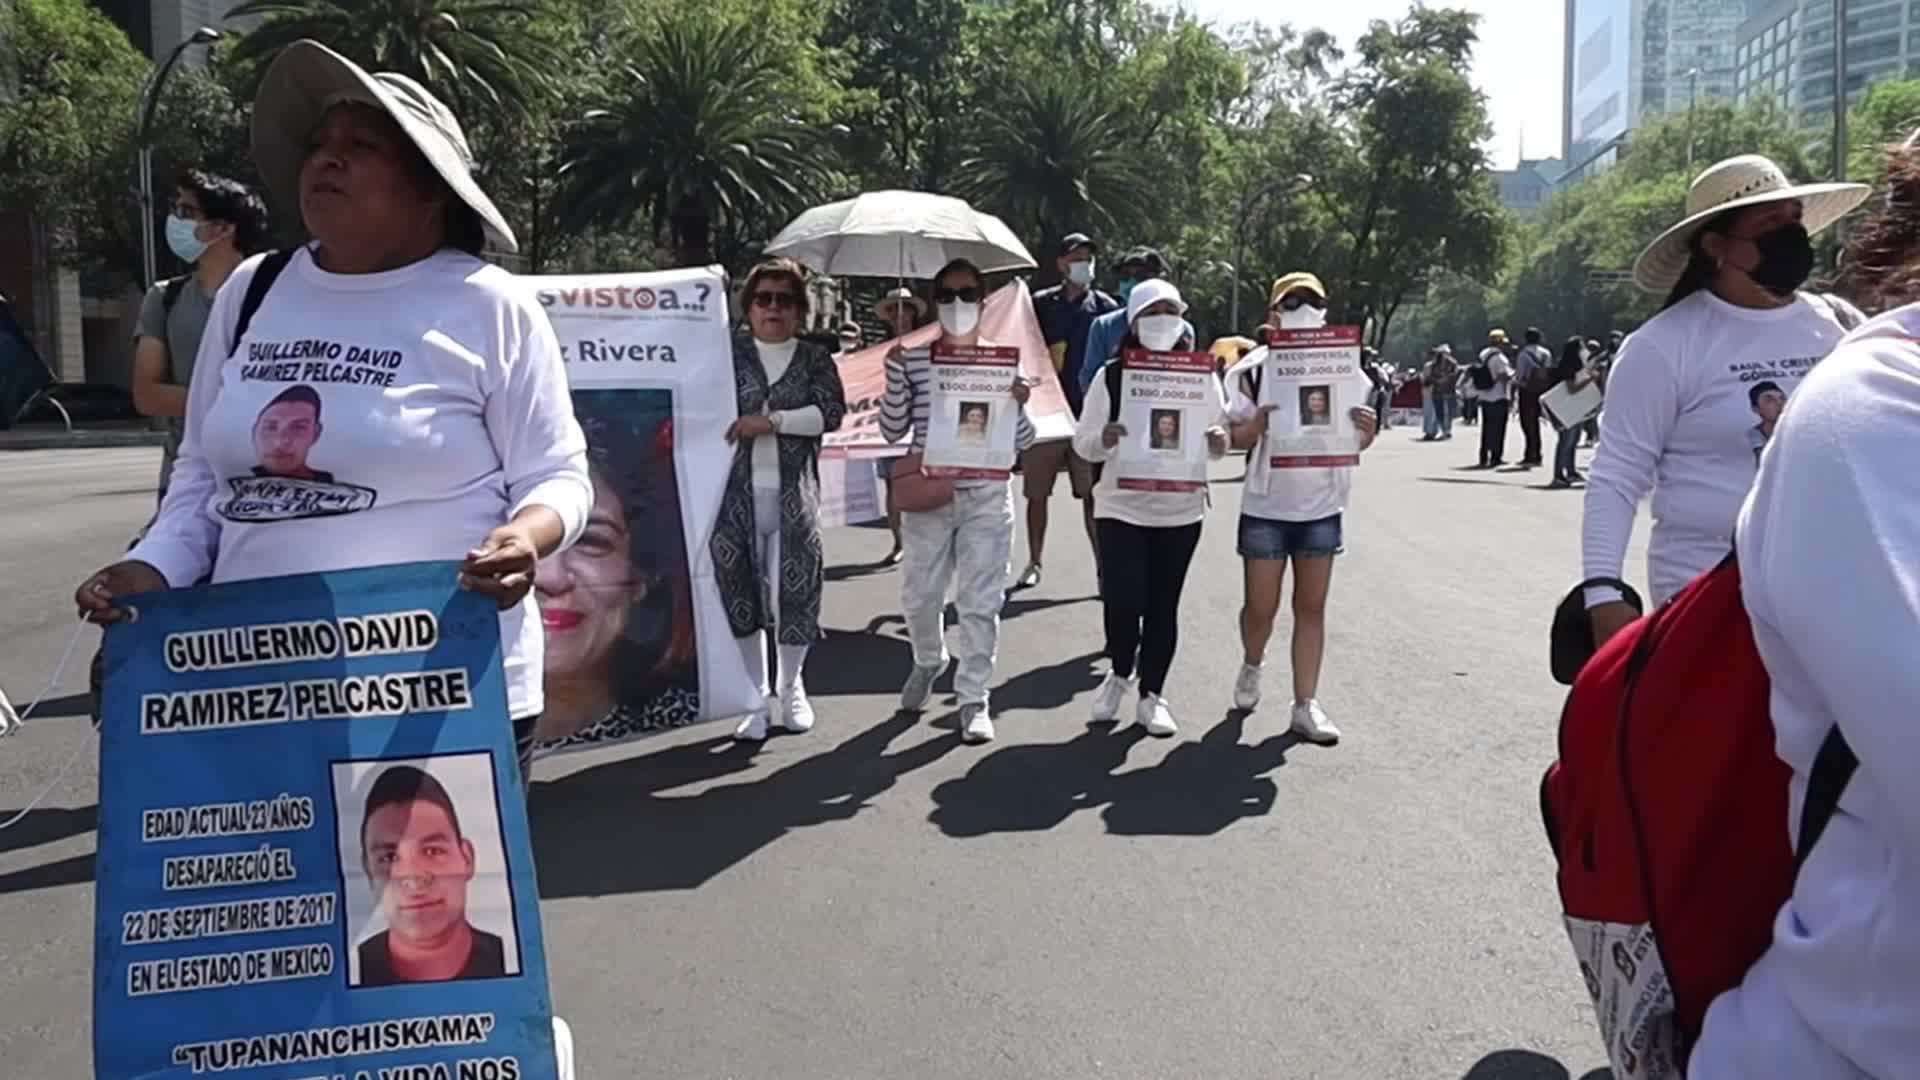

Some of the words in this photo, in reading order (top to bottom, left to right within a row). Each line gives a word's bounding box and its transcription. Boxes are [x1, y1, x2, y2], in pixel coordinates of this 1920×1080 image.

[249, 340, 342, 362] GUILLERMO
[345, 347, 403, 369] DAVID
[578, 338, 678, 363] Rivera
[1277, 351, 1352, 361] RECOMPENSA
[241, 362, 302, 383] RAMIREZ
[302, 363, 397, 387] PELCASTRE
[166, 620, 337, 670] GUILLERMO
[344, 612, 436, 654] DAVID
[144, 682, 287, 731] RAMIREZ
[295, 671, 468, 721] PELCASTRE
[144, 809, 184, 839] EDAD
[188, 804, 247, 837] ACTUAL
[250, 800, 268, 831] 23
[269, 795, 312, 829] AÑOS
[166, 847, 270, 888] DESAPARECIÓ
[274, 850, 294, 879] EL
[124, 913, 145, 942] 22
[150, 911, 170, 939] DE
[172, 898, 271, 938] SEPTIEMBRE
[275, 898, 295, 926] DE
[298, 893, 334, 925] 2017
[130, 964, 151, 993] EN
[157, 961, 176, 991] EL
[180, 954, 241, 988] ESTADO
[246, 952, 267, 981] DE
[271, 945, 332, 978] MEXICO
[459, 1059, 518, 1080] NOS
